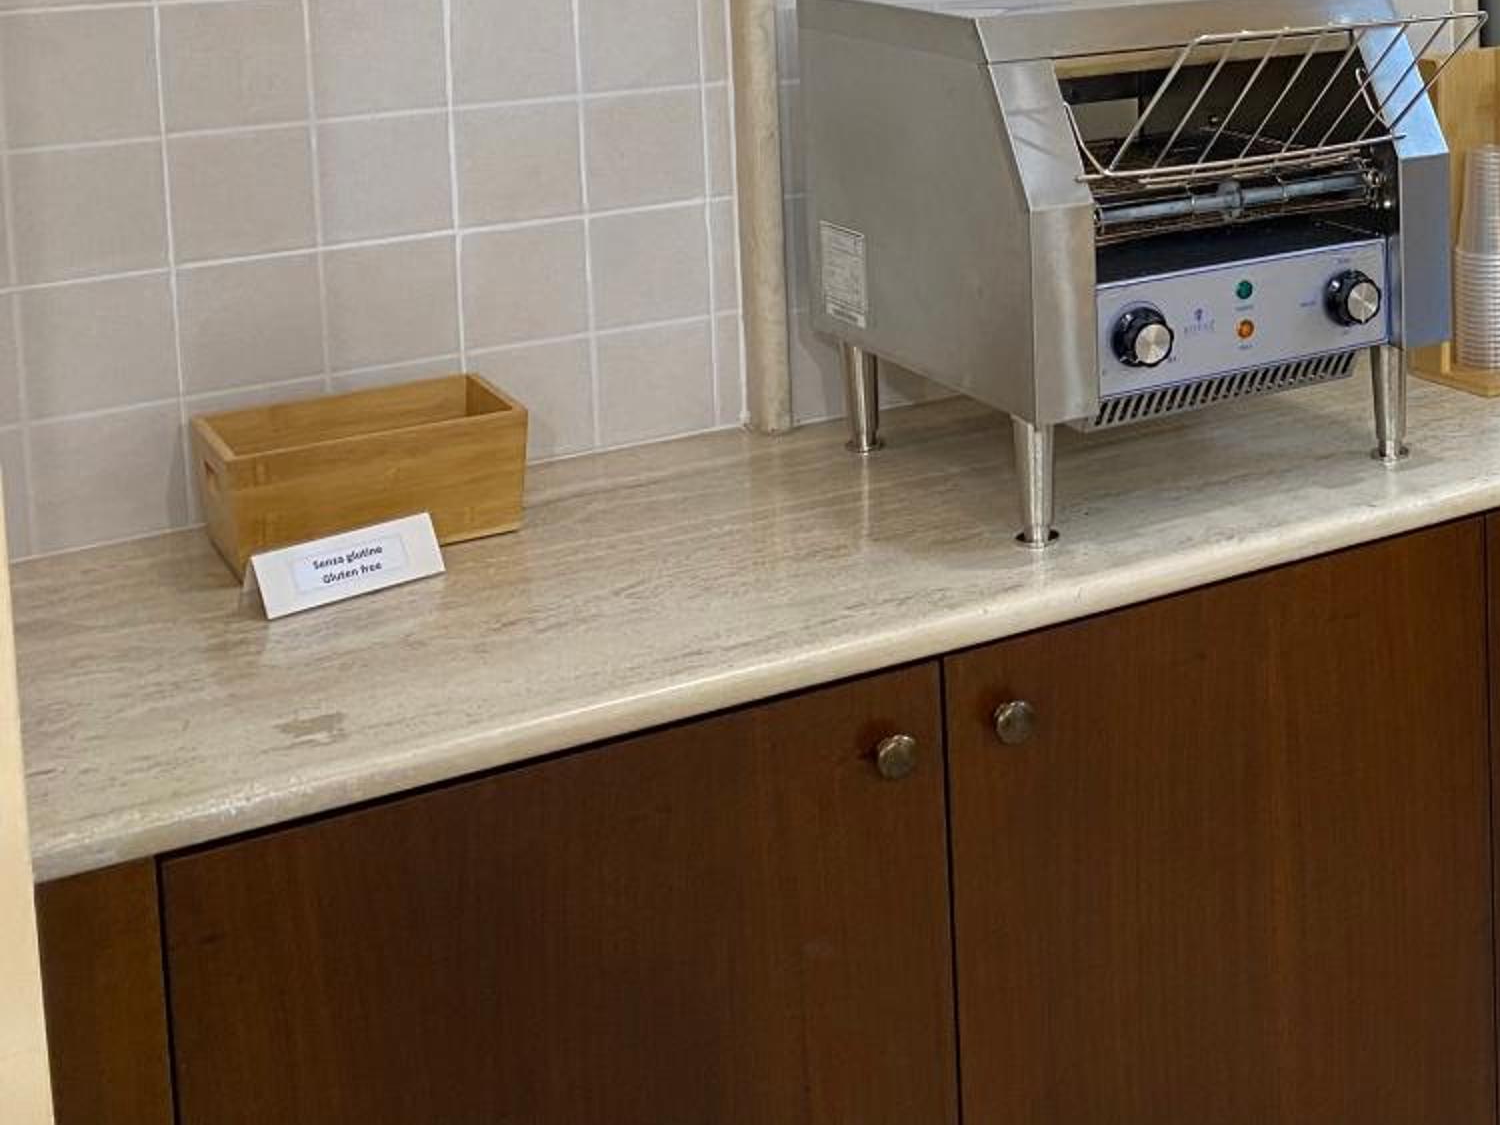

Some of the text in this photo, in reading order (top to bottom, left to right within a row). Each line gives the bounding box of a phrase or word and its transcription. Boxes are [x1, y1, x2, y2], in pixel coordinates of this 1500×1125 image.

[312, 546, 383, 570] Senza glutine
[323, 562, 382, 584] Gluten free
